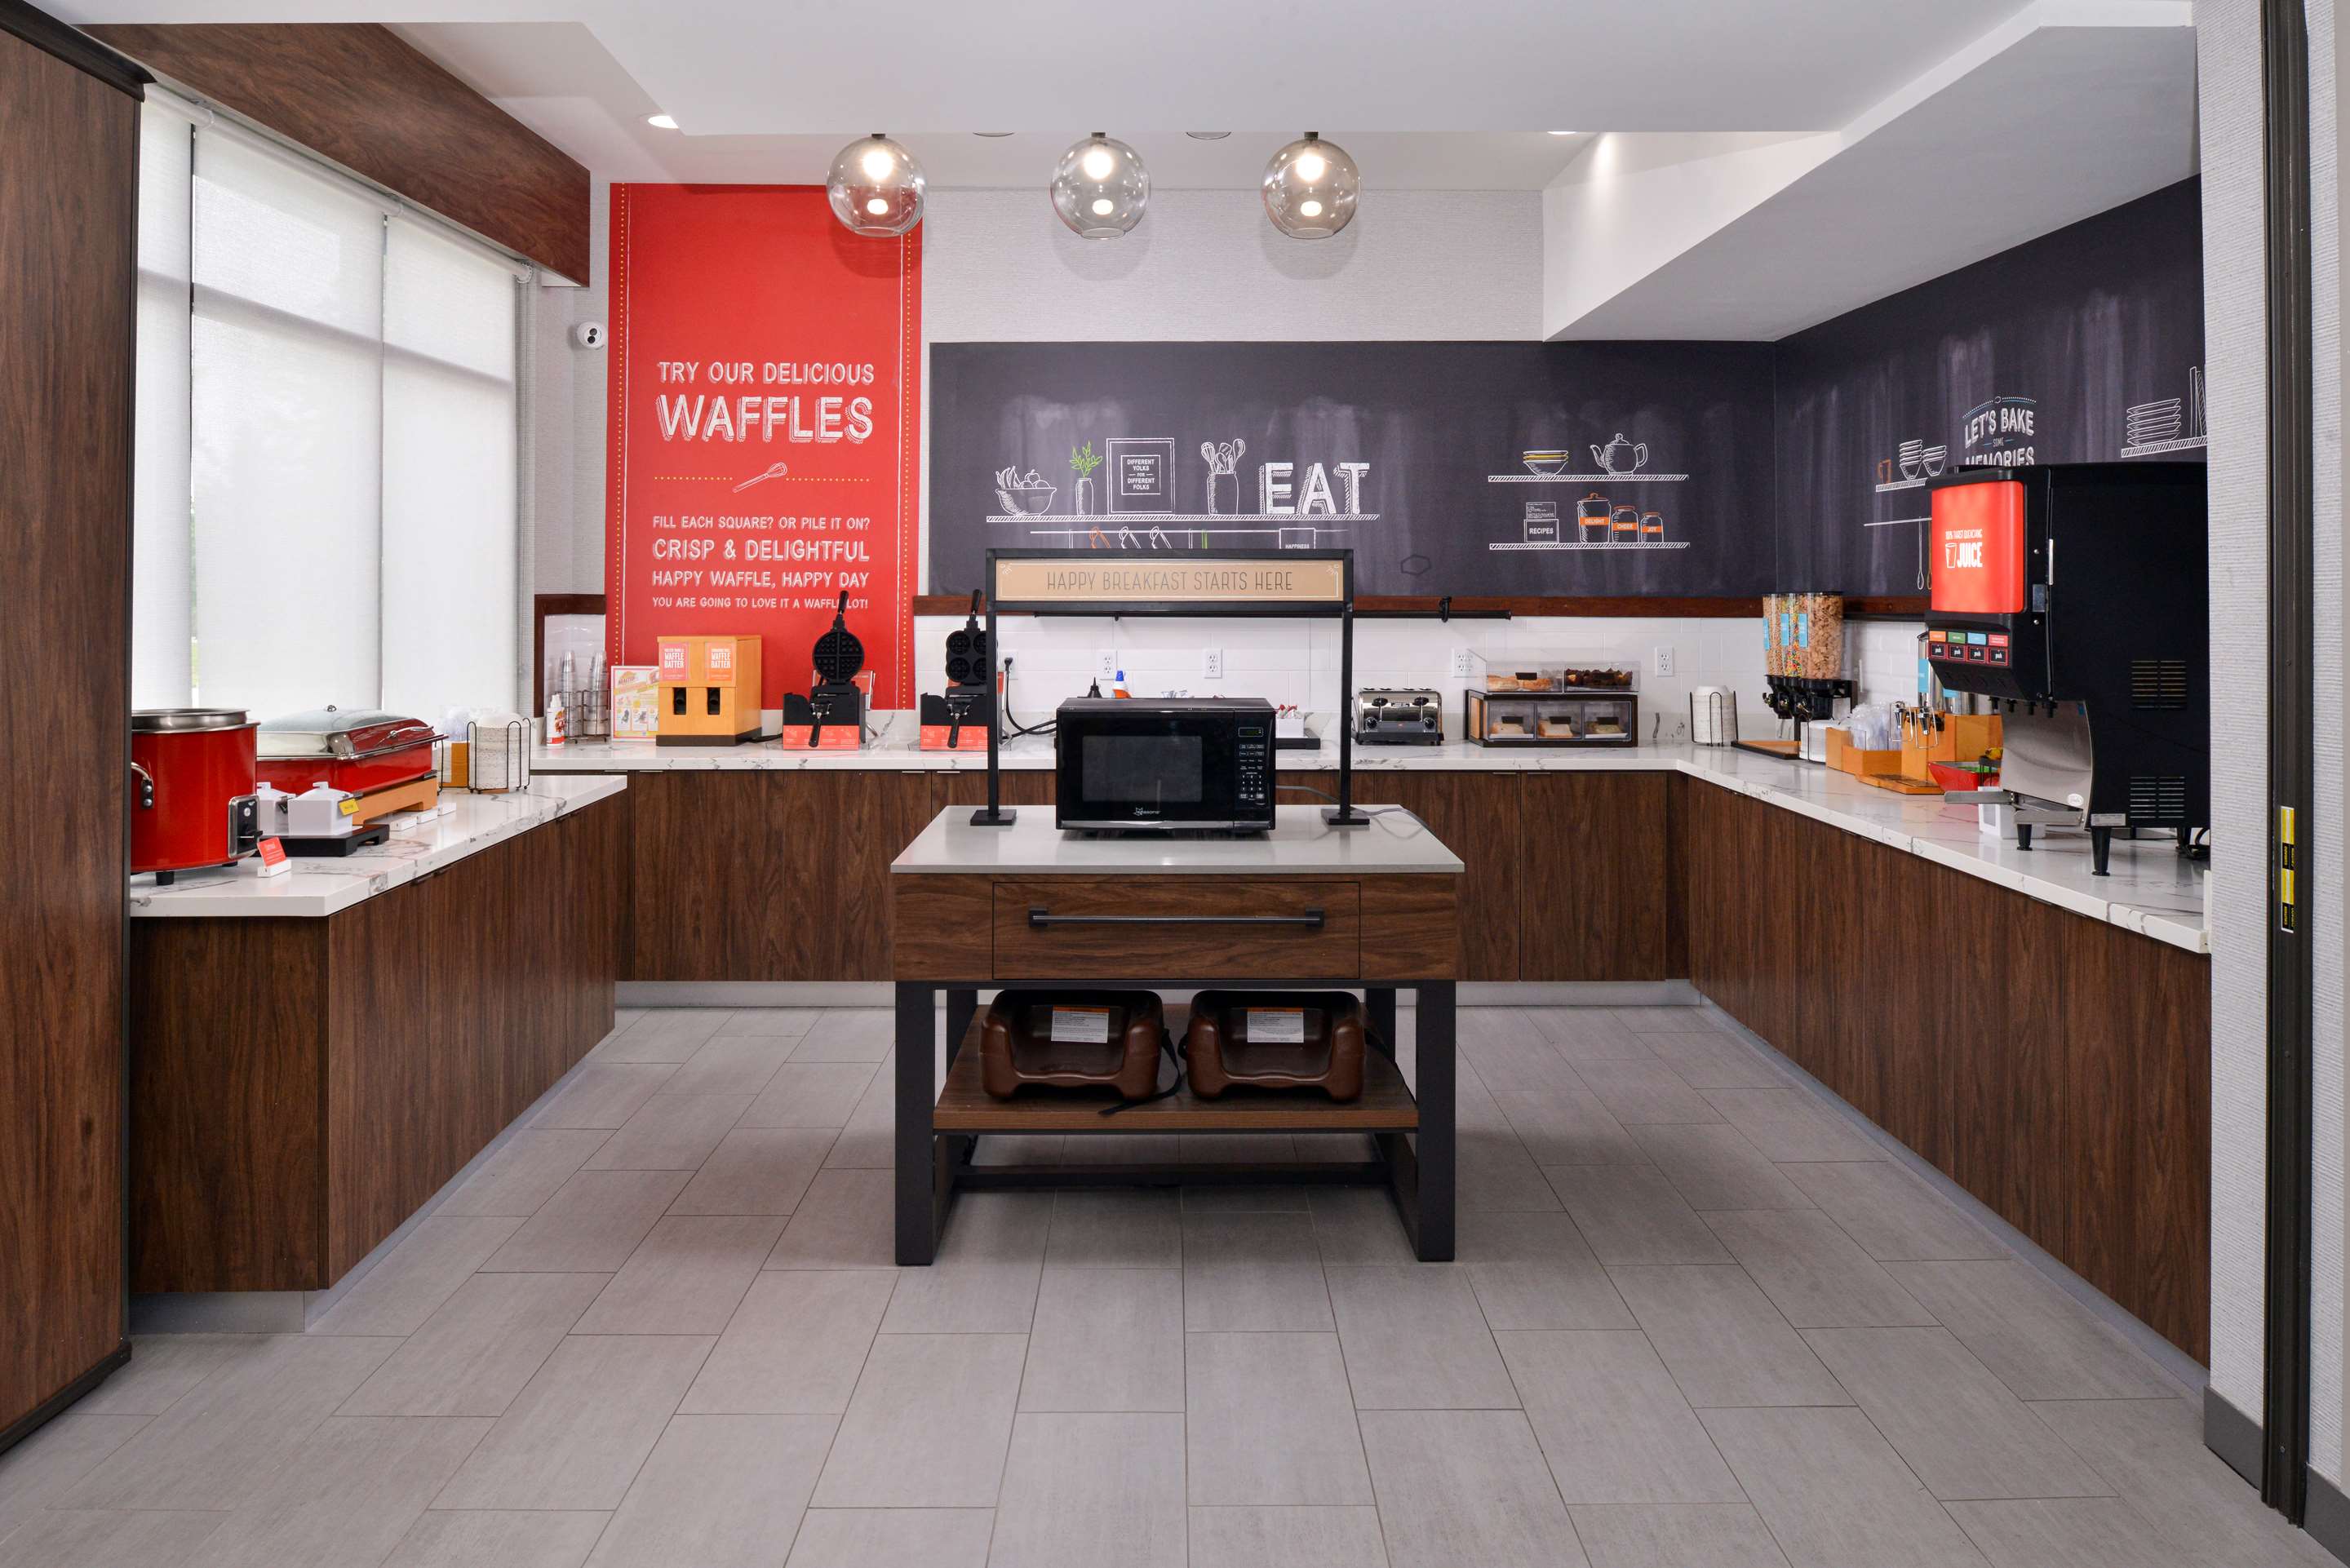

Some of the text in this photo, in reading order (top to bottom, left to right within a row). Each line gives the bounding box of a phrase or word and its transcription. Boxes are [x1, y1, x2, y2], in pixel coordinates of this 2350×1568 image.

[658, 361, 875, 386] TRY OUR DELICIOUS
[655, 393, 874, 445] WAFFLES
[1964, 407, 2035, 450] LET'S BAKE
[1259, 462, 1370, 515] EAT
[653, 516, 871, 530] FILL EACH SQUARE? OR PILE IT ON?
[653, 538, 870, 563] CRISP & DELIGHTFUL
[1957, 542, 1983, 568] JUICE
[653, 570, 870, 589] HAPPY WAFFLE, HAPPY DAY
[1047, 571, 1293, 591] HAPPY BREAKFAST STARTS HERE
[653, 596, 868, 609] YOU ARE GOING TO LOVE IT A WAFFL LOT!
[664, 652, 684, 660] WAFFLE
[664, 660, 684, 668] BATTER
[711, 652, 731, 660] WAFFLE
[711, 660, 731, 669] BATTER
